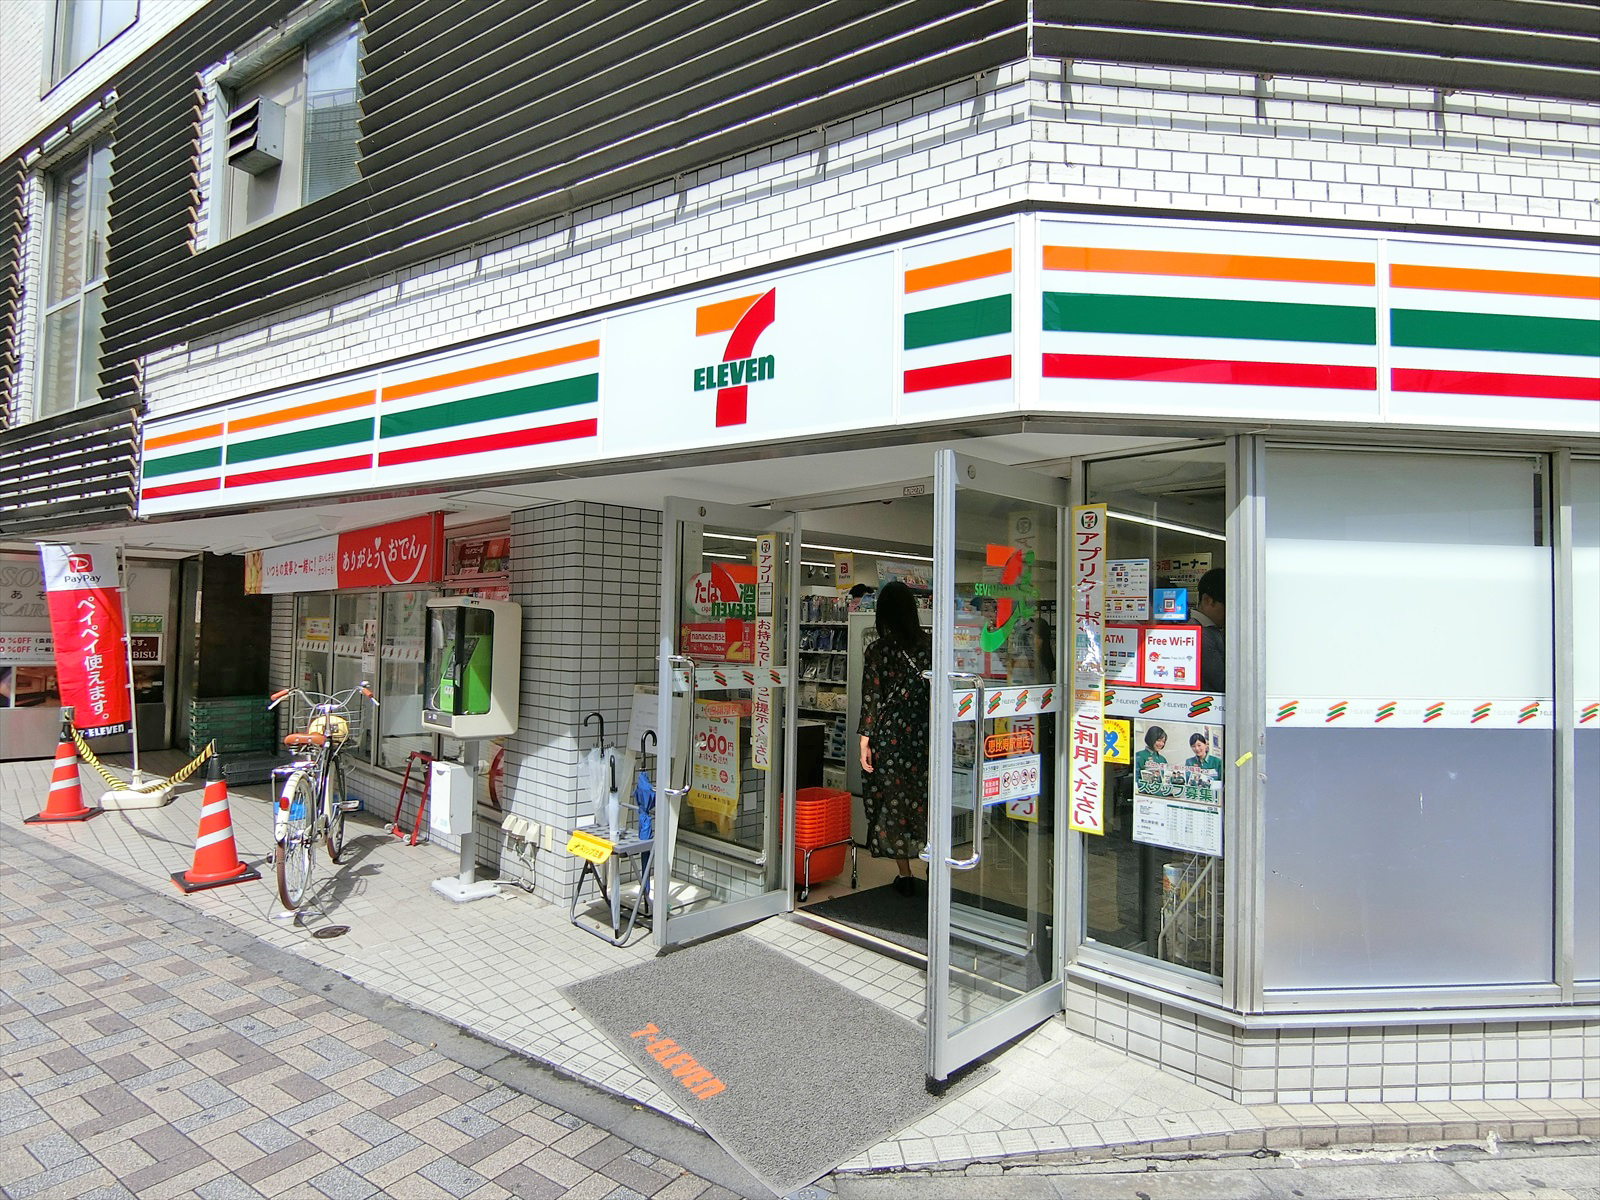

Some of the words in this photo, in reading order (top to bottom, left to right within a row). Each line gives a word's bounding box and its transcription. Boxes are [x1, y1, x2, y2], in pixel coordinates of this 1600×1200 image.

[695, 287, 776, 428] 7
[64, 574, 101, 584] PayPay
[1104, 635, 1124, 643] ATM
[1147, 636, 1168, 646] Free
[1169, 637, 1194, 647] Wi-Fi
[77, 596, 110, 720] ペイペイ使えます。
[1073, 714, 1100, 828] ご利用ください
[1138, 780, 1219, 804] スタッフ募集!
